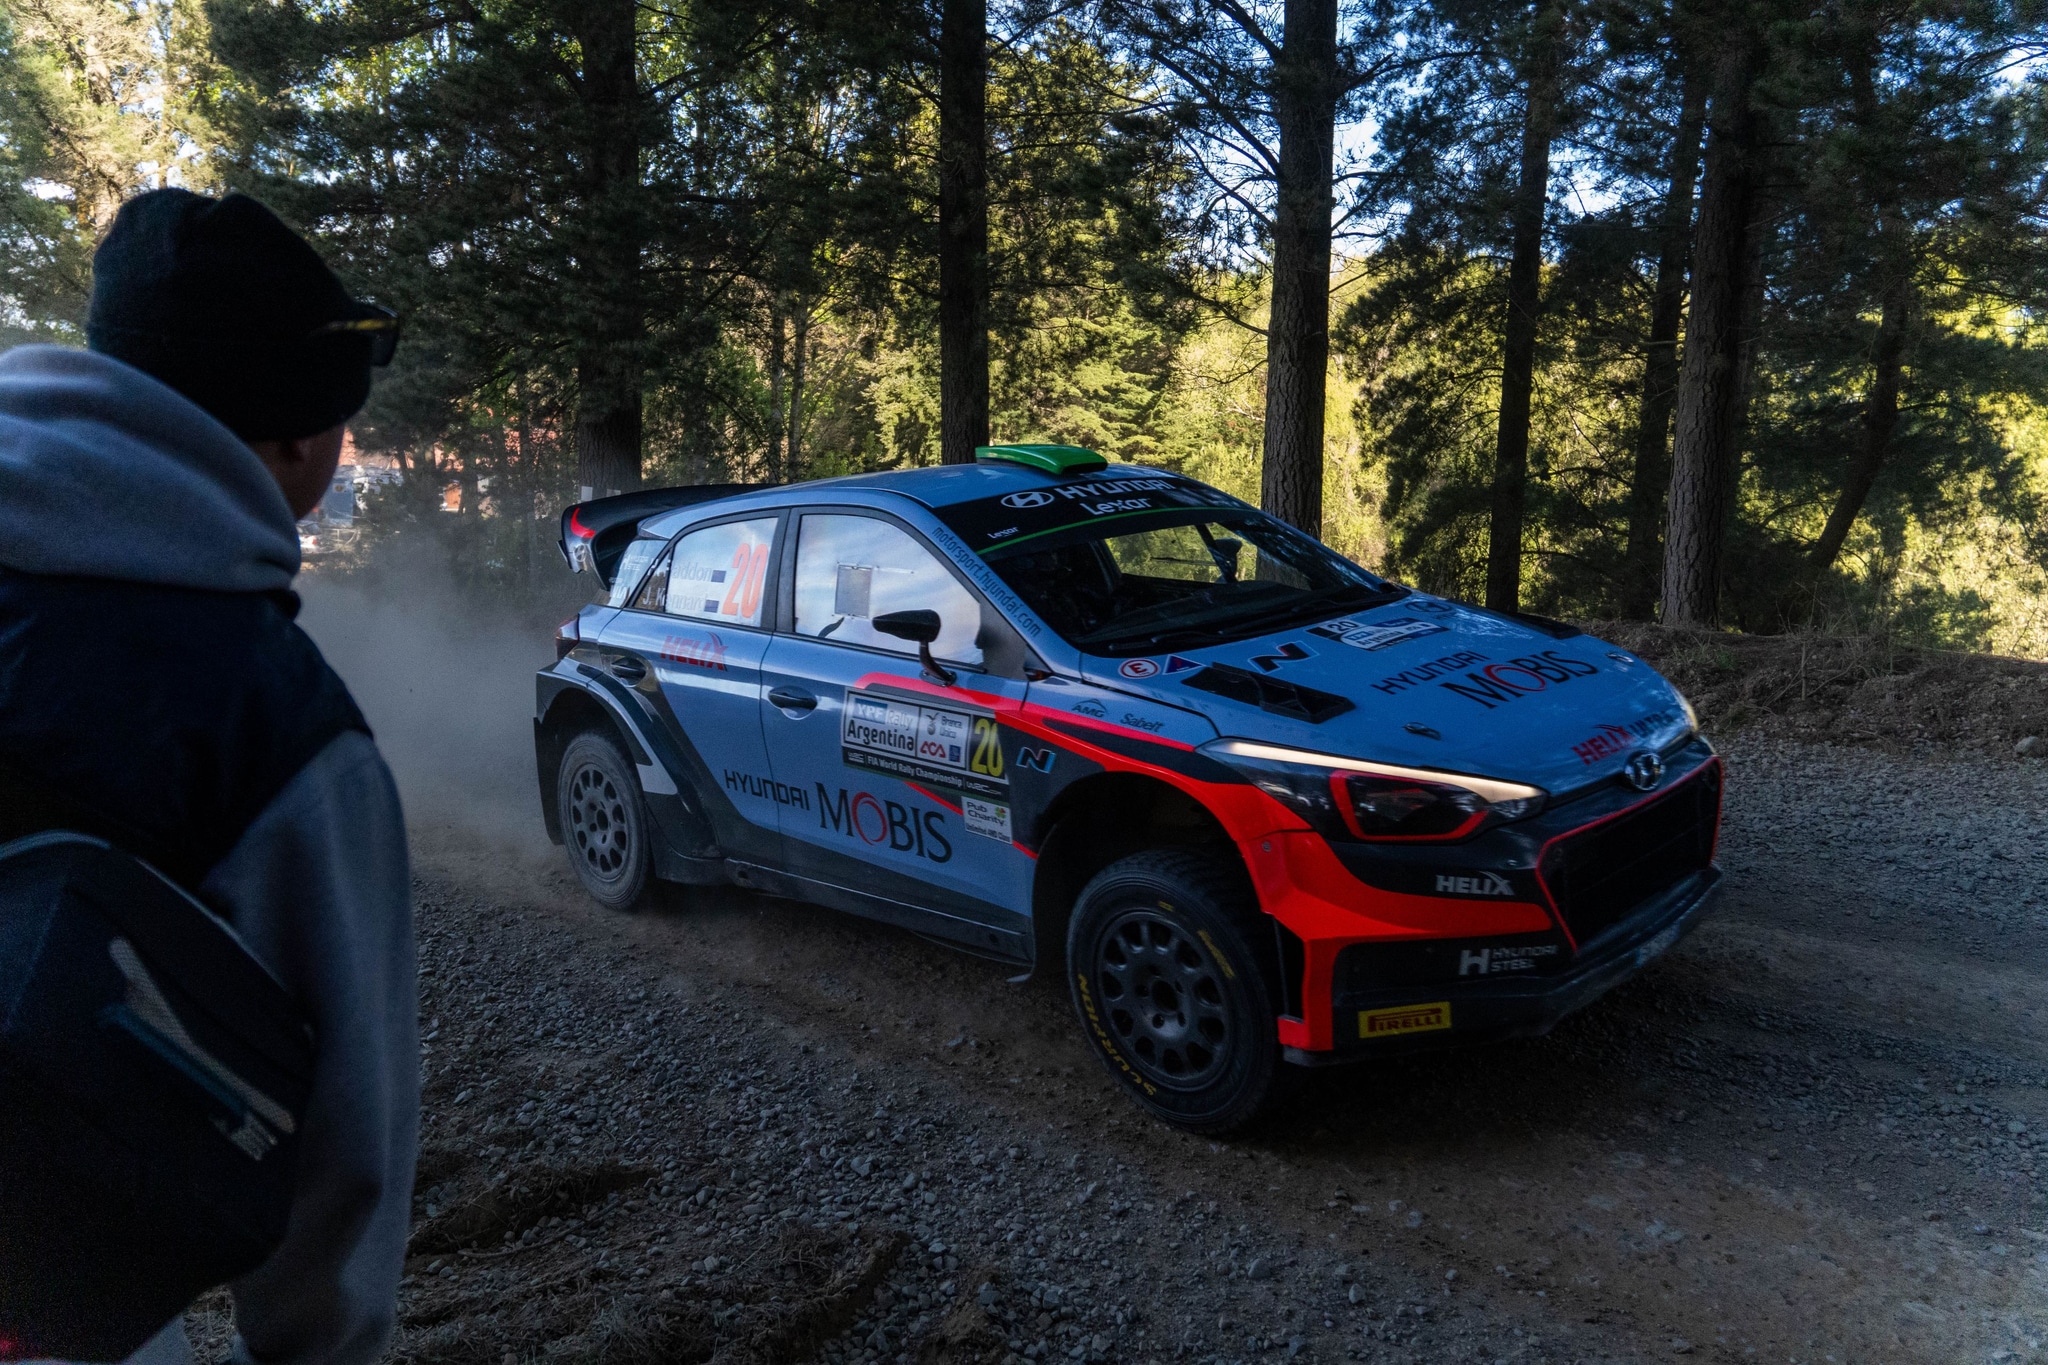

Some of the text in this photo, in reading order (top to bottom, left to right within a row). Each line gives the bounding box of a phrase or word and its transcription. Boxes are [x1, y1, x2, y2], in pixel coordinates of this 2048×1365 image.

[1053, 480, 1177, 499] HYUNDAI
[1080, 496, 1152, 516] Lexar
[987, 526, 1019, 539] Lexar
[723, 543, 769, 618] 20
[932, 527, 1041, 638] motorsport.hyundai.com
[1331, 621, 1358, 633] 20
[661, 631, 728, 671] HELIX
[1371, 651, 1599, 709] HYUNDAI MOBIS
[886, 709, 914, 731] Rally
[1121, 713, 1164, 733] Sabelt
[847, 720, 915, 751] Argentina
[971, 718, 1004, 777] 20
[1571, 725, 1633, 765] HELIX
[867, 755, 963, 788] FIA World Rally Championship
[724, 769, 953, 863] HYUNDAI MOBIS
[967, 801, 988, 814] Pub
[968, 809, 1005, 827] Charity
[1435, 871, 1515, 896] HELIX
[1491, 945, 1559, 959] HYUNDAI
[1490, 958, 1536, 972] STEEL
[1368, 1008, 1442, 1032] PIRELLI
